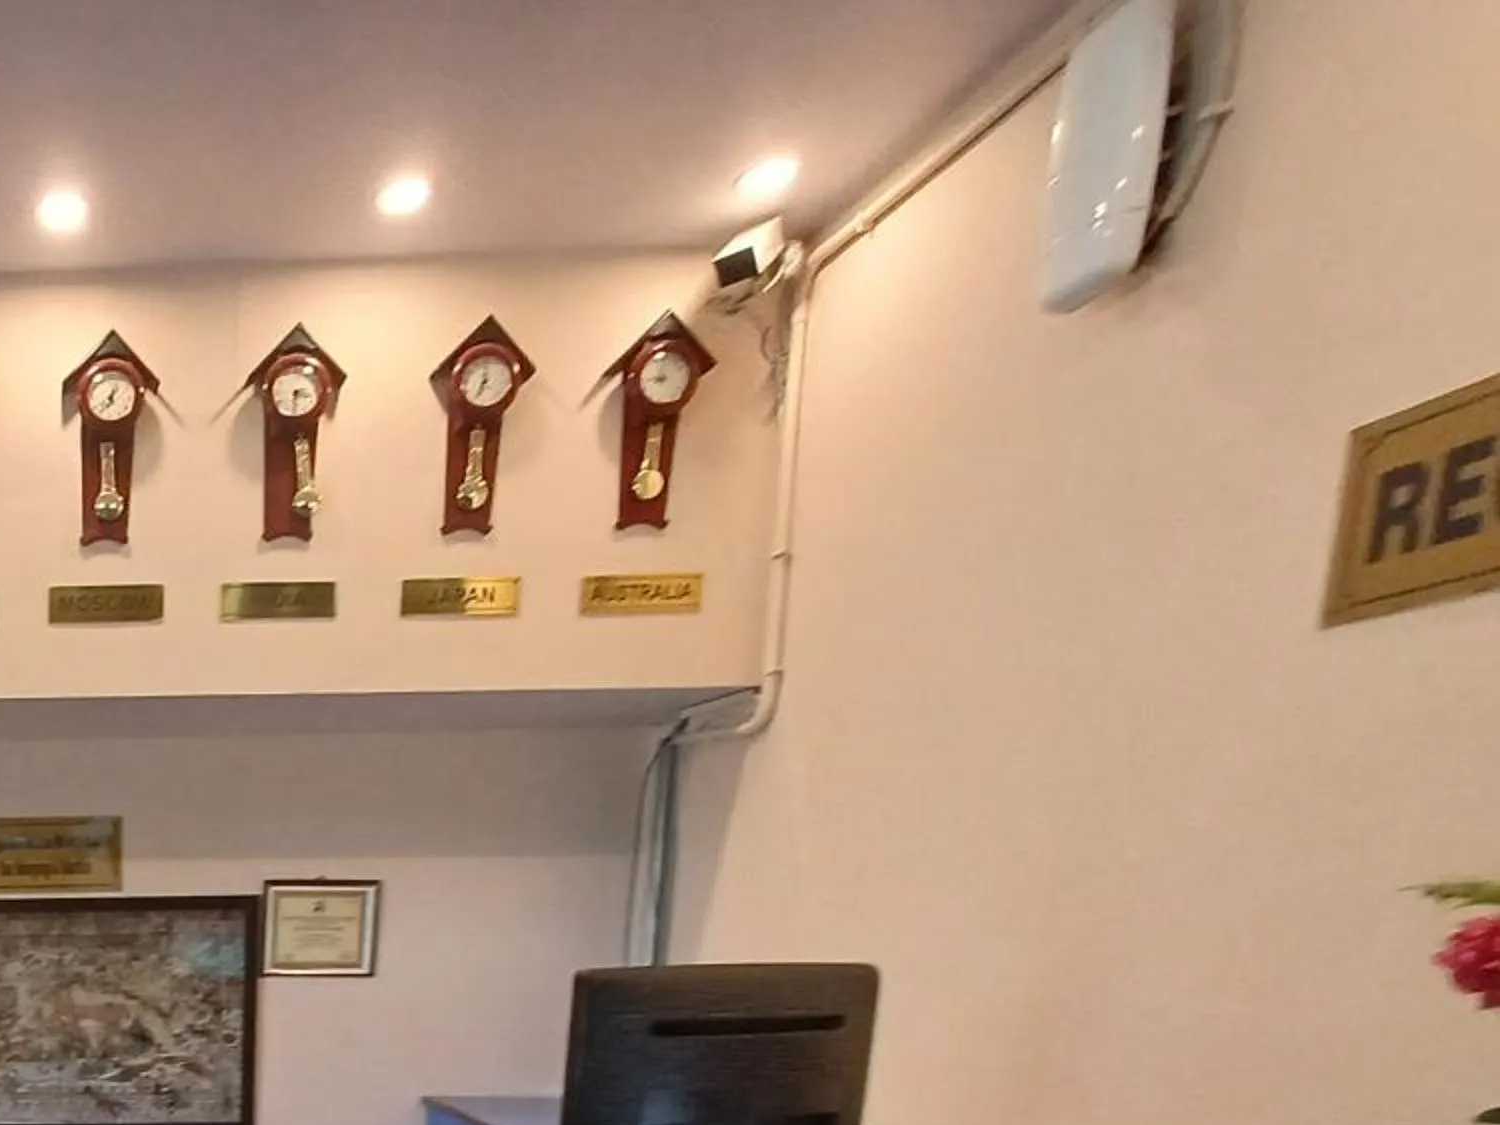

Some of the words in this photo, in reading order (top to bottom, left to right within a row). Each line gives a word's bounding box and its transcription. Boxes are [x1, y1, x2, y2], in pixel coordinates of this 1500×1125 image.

[1364, 434, 1500, 564] RE
[428, 586, 497, 604] JAPAN
[589, 581, 692, 602] AUSTRALIA
